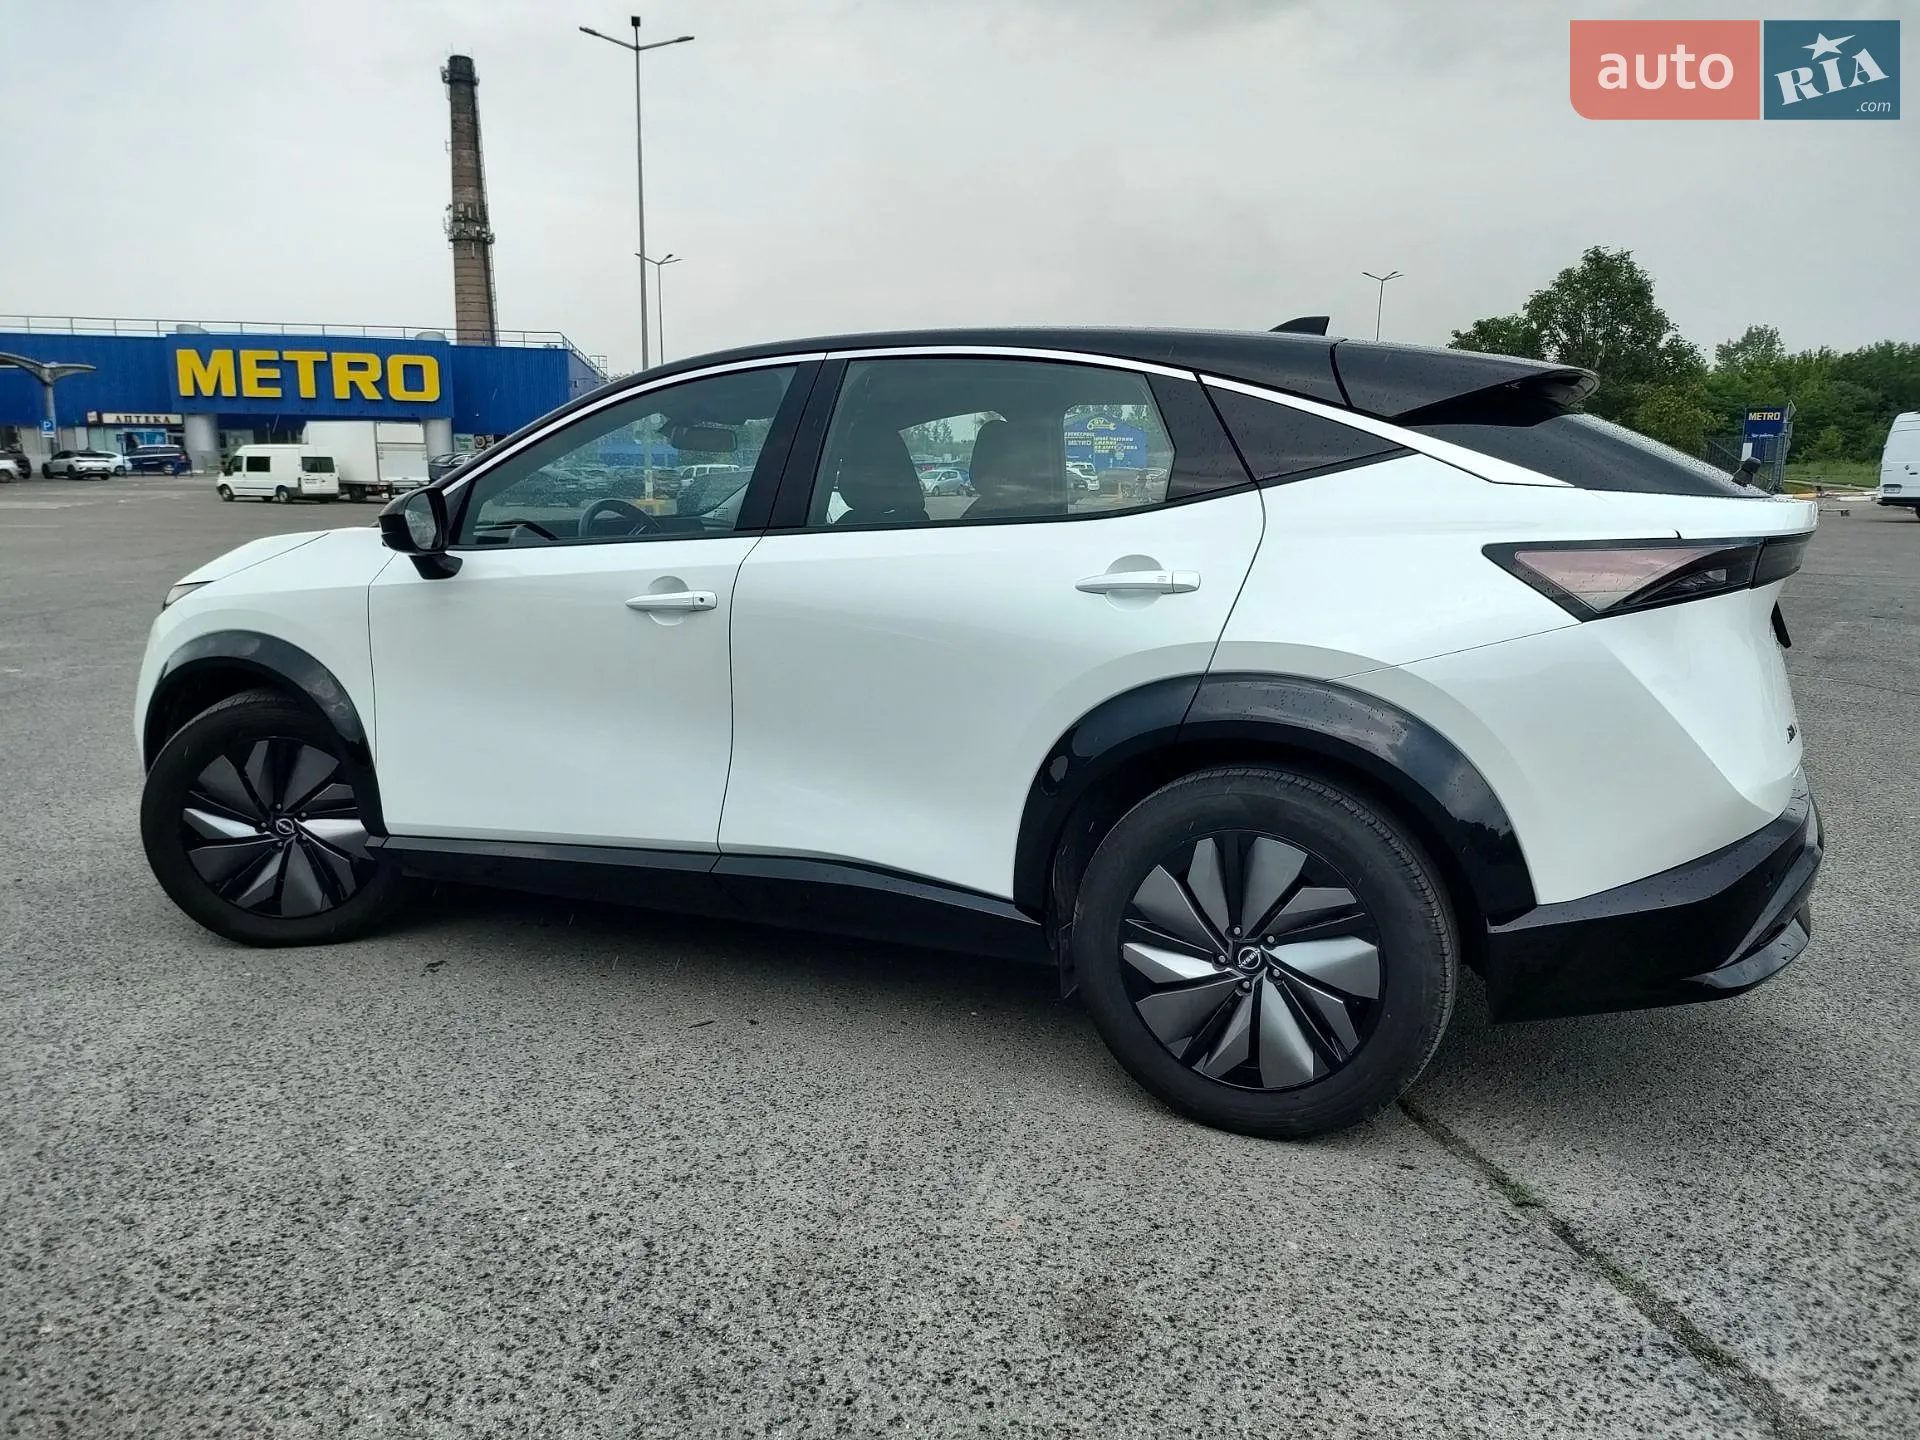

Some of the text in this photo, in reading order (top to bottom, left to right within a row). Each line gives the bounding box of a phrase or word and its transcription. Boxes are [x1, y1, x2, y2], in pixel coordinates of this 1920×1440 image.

[176, 349, 440, 402] METRO
[114, 415, 171, 424] АПТЕКА
[1748, 411, 1781, 421] METRO
[43, 421, 52, 431] P
